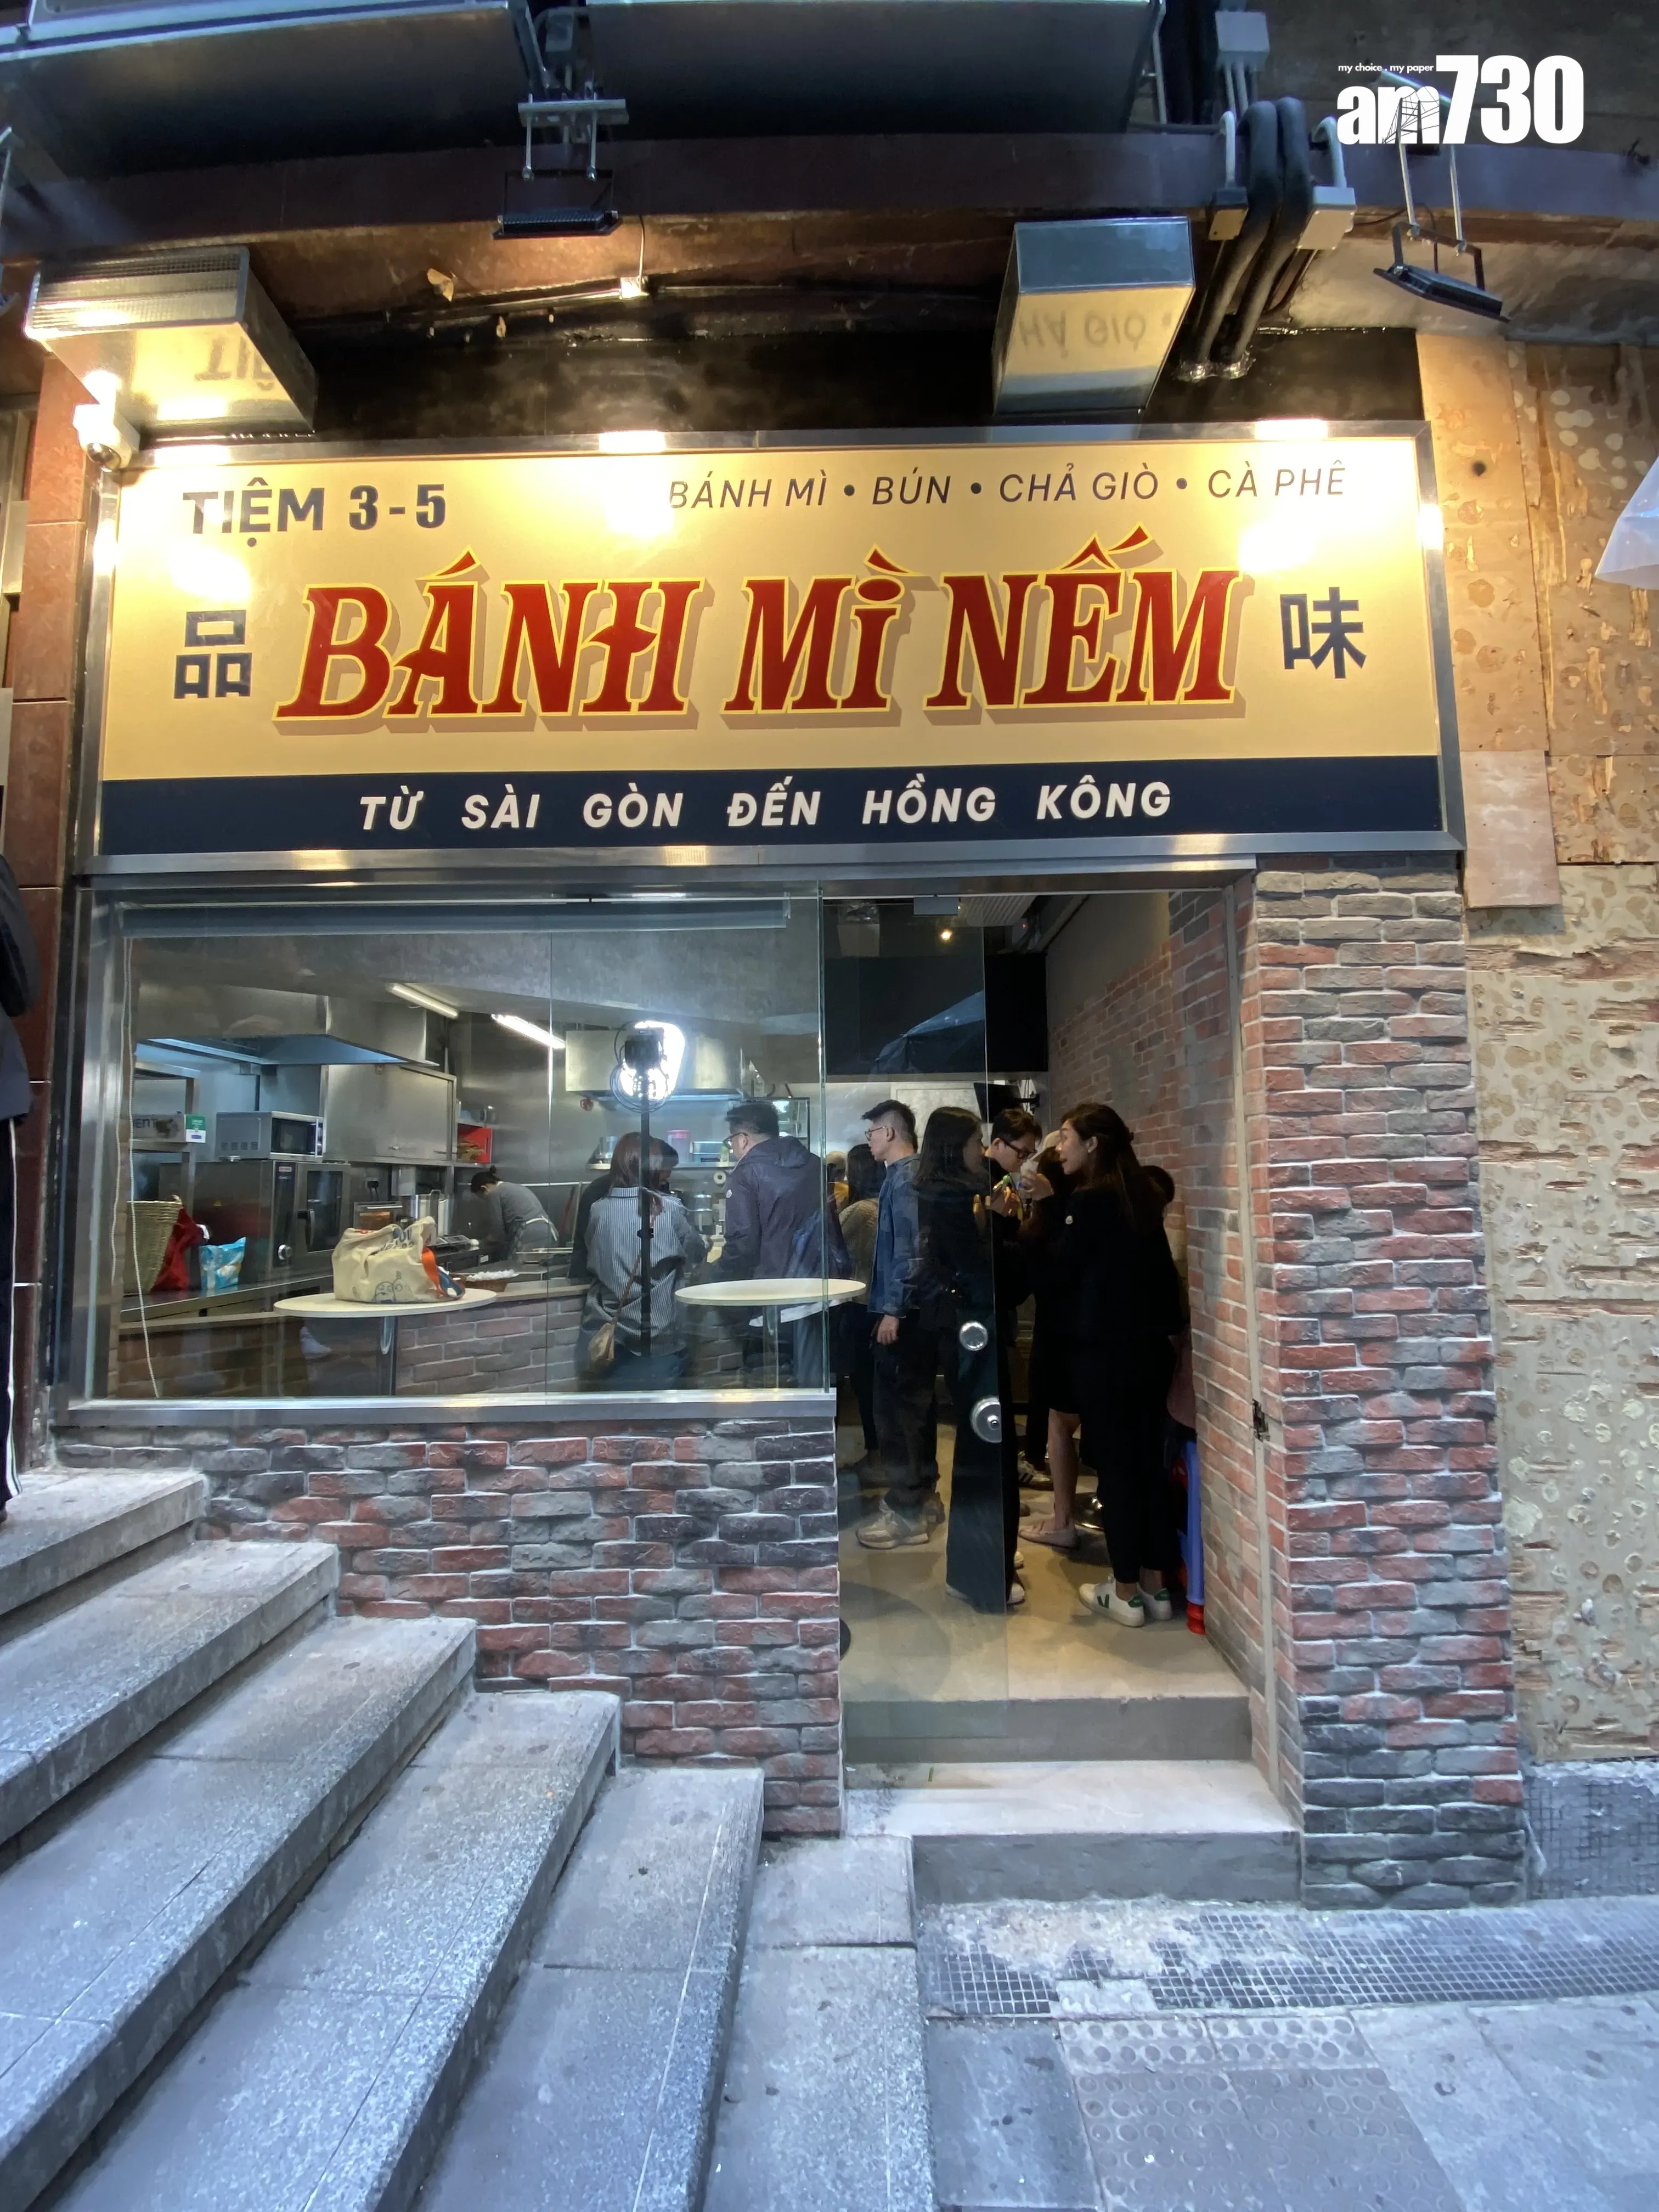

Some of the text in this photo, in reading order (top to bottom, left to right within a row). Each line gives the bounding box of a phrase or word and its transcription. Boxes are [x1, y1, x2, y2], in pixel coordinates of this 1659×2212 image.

[183, 476, 445, 548] TIỆM 3-5
[669, 459, 1346, 509] BÁNH MÌ BÚN CHẢ GIÒ CÀ PHÊ
[173, 610, 252, 699] 品
[272, 545, 705, 721] BÁNH
[923, 522, 1243, 711] NẾM
[1280, 586, 1367, 679] 味
[360, 773, 1172, 830] TỪ SÀI GÒN ĐẾN HỒNG KÔNG
